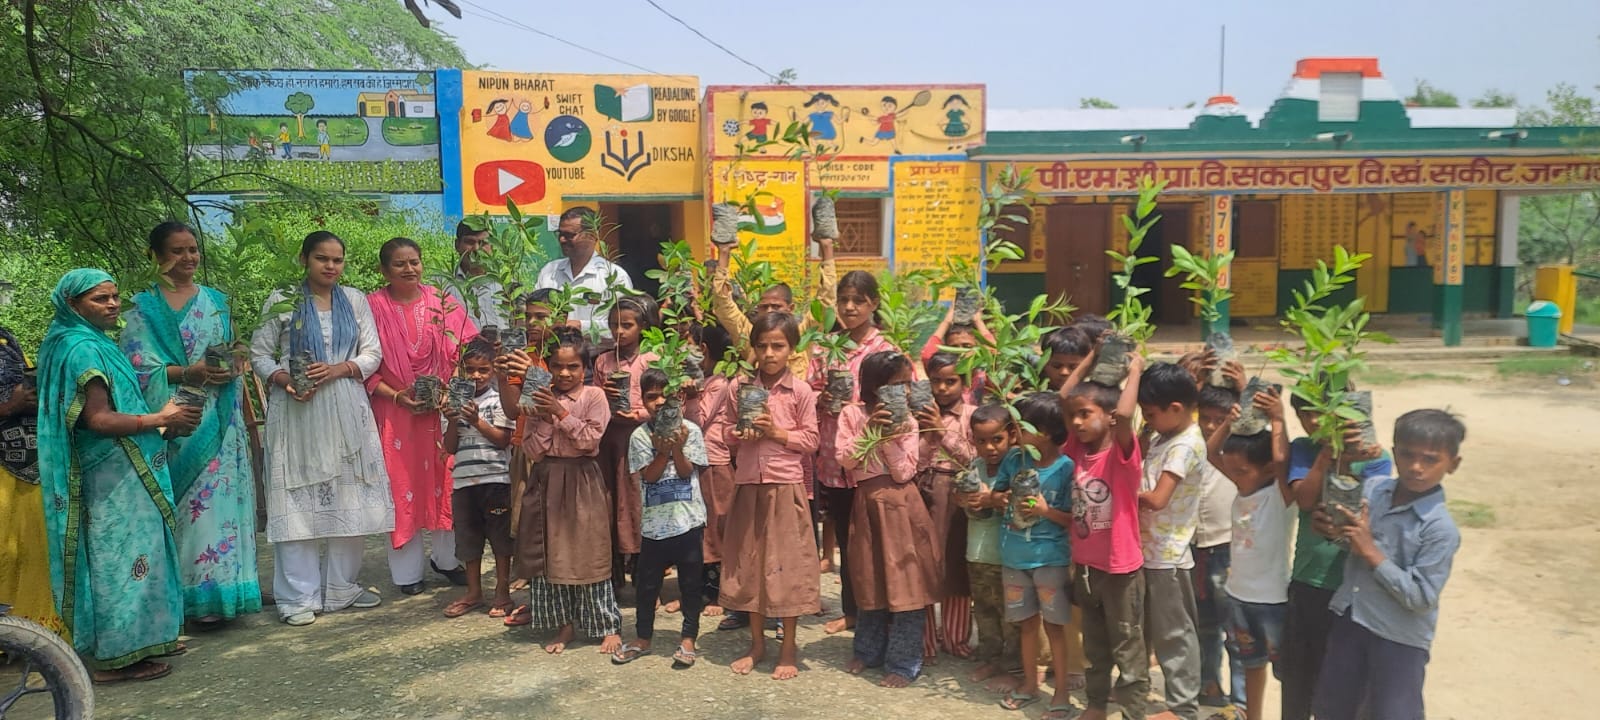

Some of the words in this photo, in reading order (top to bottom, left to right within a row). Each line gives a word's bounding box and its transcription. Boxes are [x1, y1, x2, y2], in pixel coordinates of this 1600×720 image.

[478, 77, 509, 91] NIPUN
[514, 78, 555, 91] BHARAT
[556, 94, 582, 104] SWIFT
[653, 86, 696, 101] READALONG
[559, 105, 584, 115] CHAT
[657, 109, 668, 122] BY
[668, 109, 697, 123] GOOGLE
[652, 147, 695, 162] DIKSHA
[545, 167, 585, 180] YOUTUBE
[1217, 196, 1228, 210] 6
[1217, 212, 1227, 229] 7
[1217, 234, 1225, 248] 8
